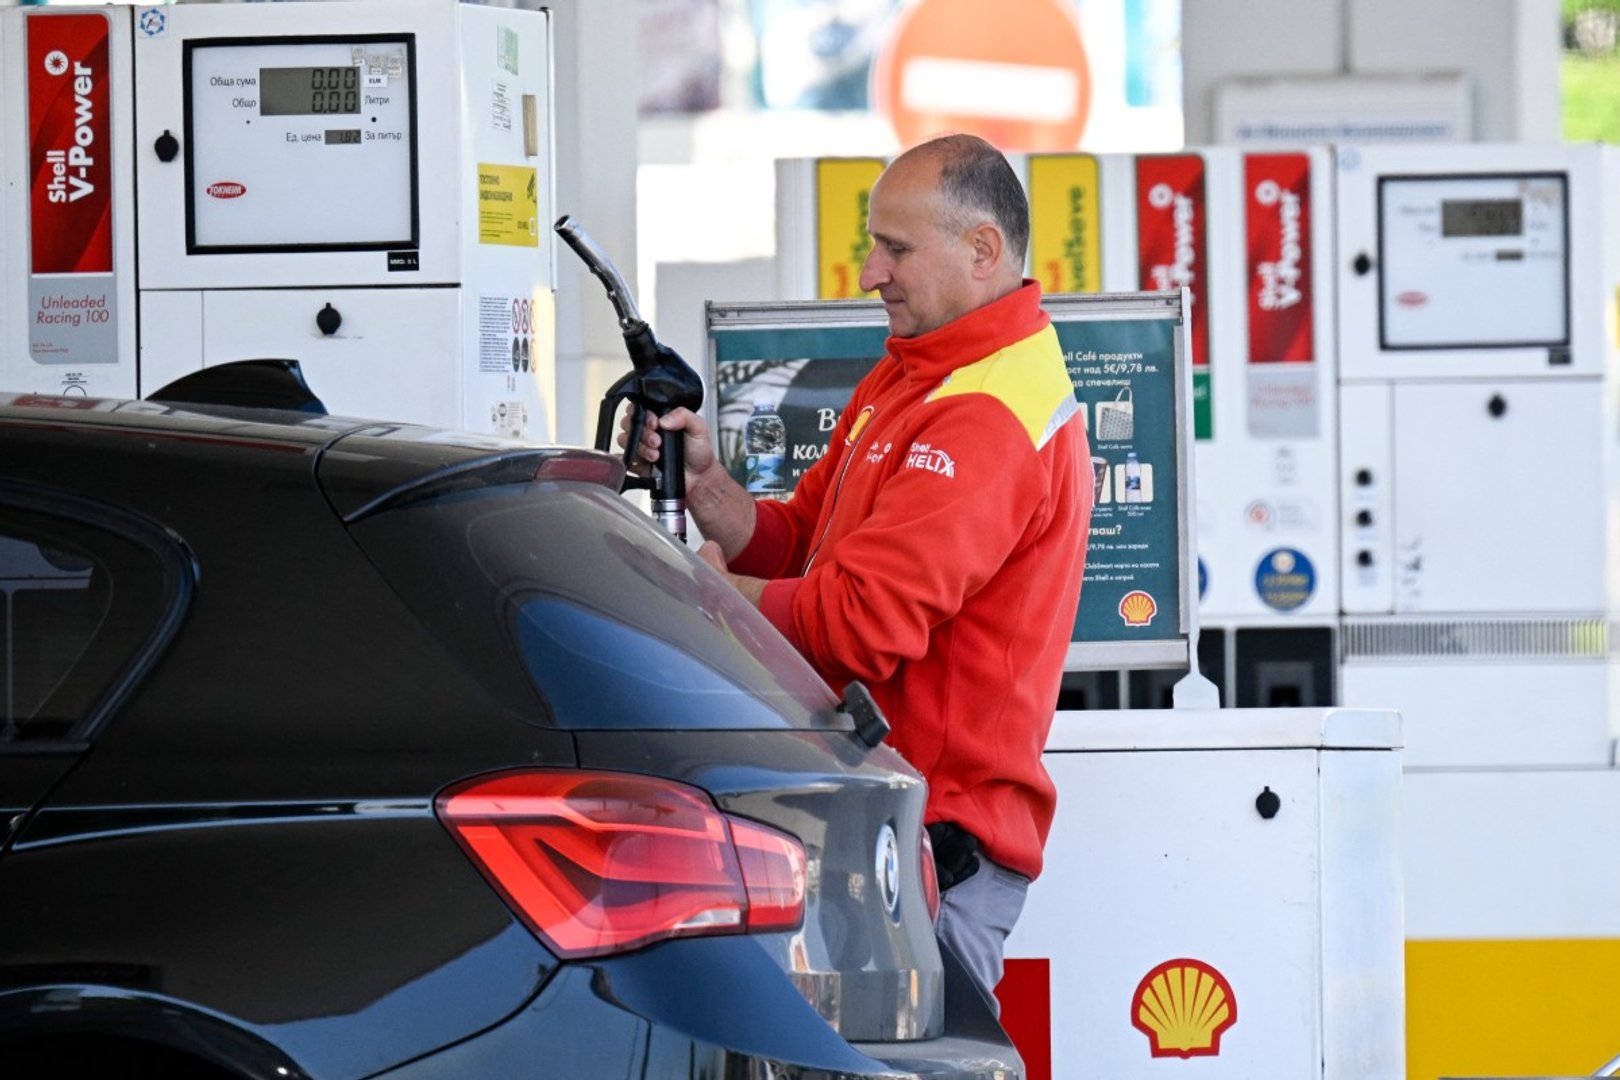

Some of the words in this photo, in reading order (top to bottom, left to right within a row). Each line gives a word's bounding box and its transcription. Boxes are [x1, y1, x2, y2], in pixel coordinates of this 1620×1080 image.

[210, 77, 234, 87] Обща
[236, 78, 257, 88] сума
[311, 68, 356, 91] 0.00
[232, 98, 257, 109] Общо
[311, 91, 356, 113] 0.00
[69, 61, 94, 202] V-Power
[46, 150, 66, 203] Shell
[41, 295, 105, 309] Unleaded
[37, 311, 80, 327] Racing
[86, 309, 109, 323] 100
[1076, 351, 1097, 361] Café
[1099, 353, 1143, 362] продукти
[1103, 363, 1142, 375] 5€/9,78
[910, 442, 931, 453] Shell
[906, 449, 955, 478] HELIX
